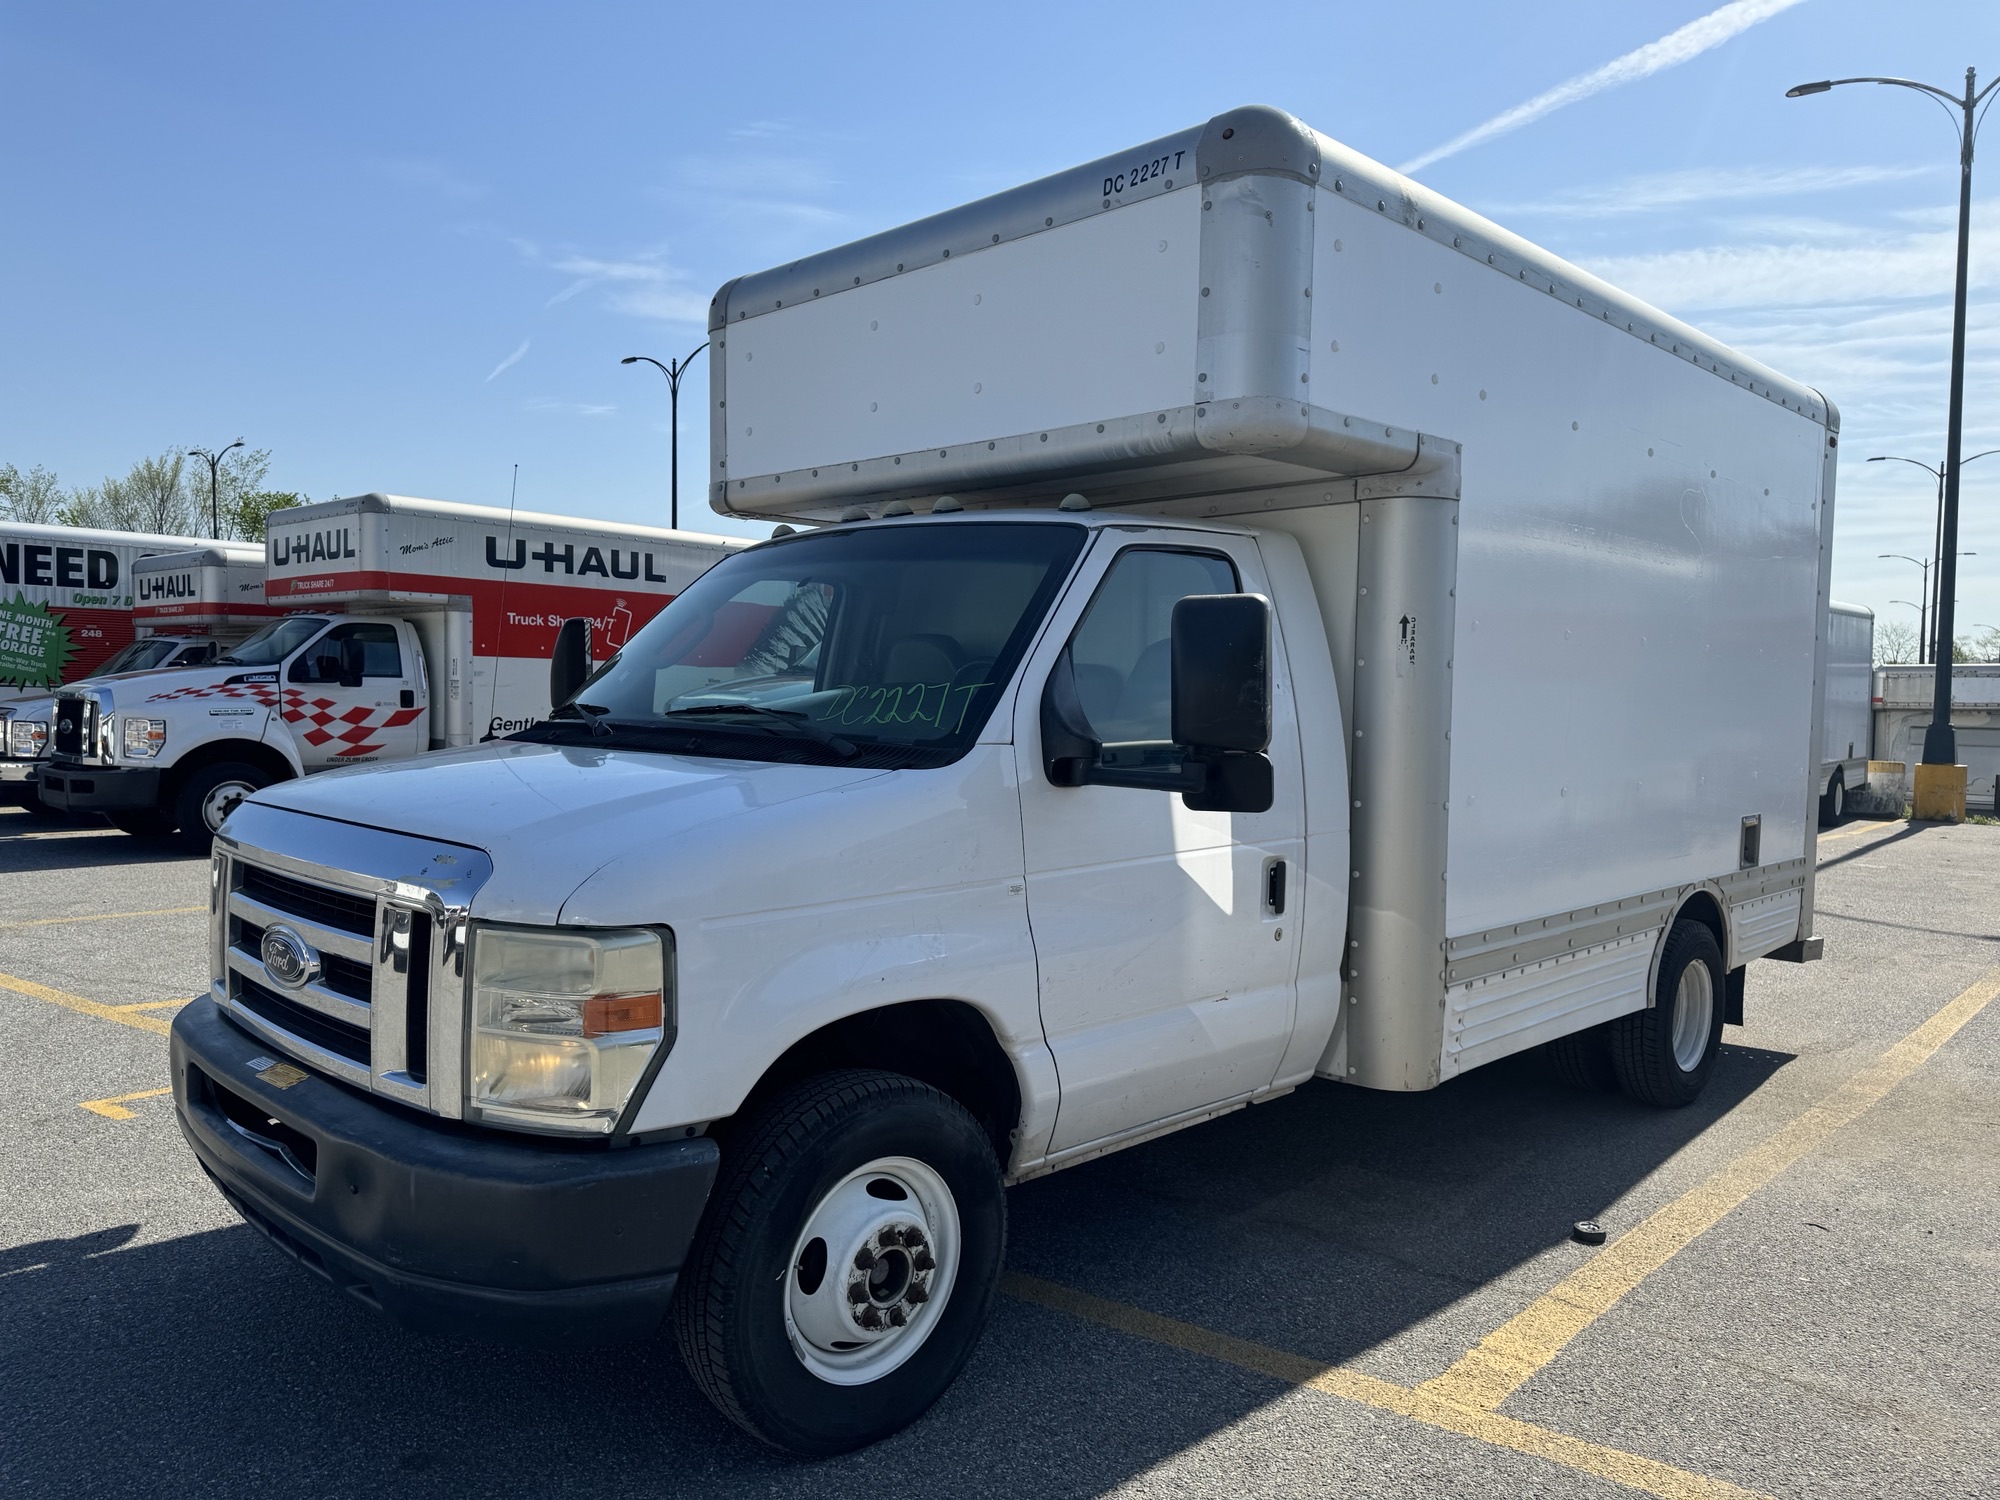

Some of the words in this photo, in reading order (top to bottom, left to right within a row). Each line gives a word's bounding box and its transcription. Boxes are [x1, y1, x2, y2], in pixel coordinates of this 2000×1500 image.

[1103, 174, 1124, 196] DC
[1130, 156, 1169, 187] 2227
[1174, 150, 1186, 170] T
[274, 528, 355, 566] U-HAUL
[400, 543, 428, 555] Mom's
[431, 537, 455, 548] Attic
[0, 543, 119, 589] NEED
[486, 536, 666, 583] U-HAUL
[140, 574, 195, 600] U-HAUL
[72, 593, 107, 606] Open
[112, 595, 121, 605] 7
[0, 609, 12, 620] NE
[15, 613, 54, 629] MONTH
[507, 612, 544, 626] Truck
[0, 621, 44, 645] FREE
[81, 629, 103, 638] 248
[0, 639, 46, 658] ORAGE
[0, 661, 16, 669] railer
[17, 664, 37, 673] Rental
[1, 654, 29, 666] One-Way
[30, 660, 47, 669] Truck
[491, 716, 535, 731] Gentl
[266, 941, 291, 971] Ford
